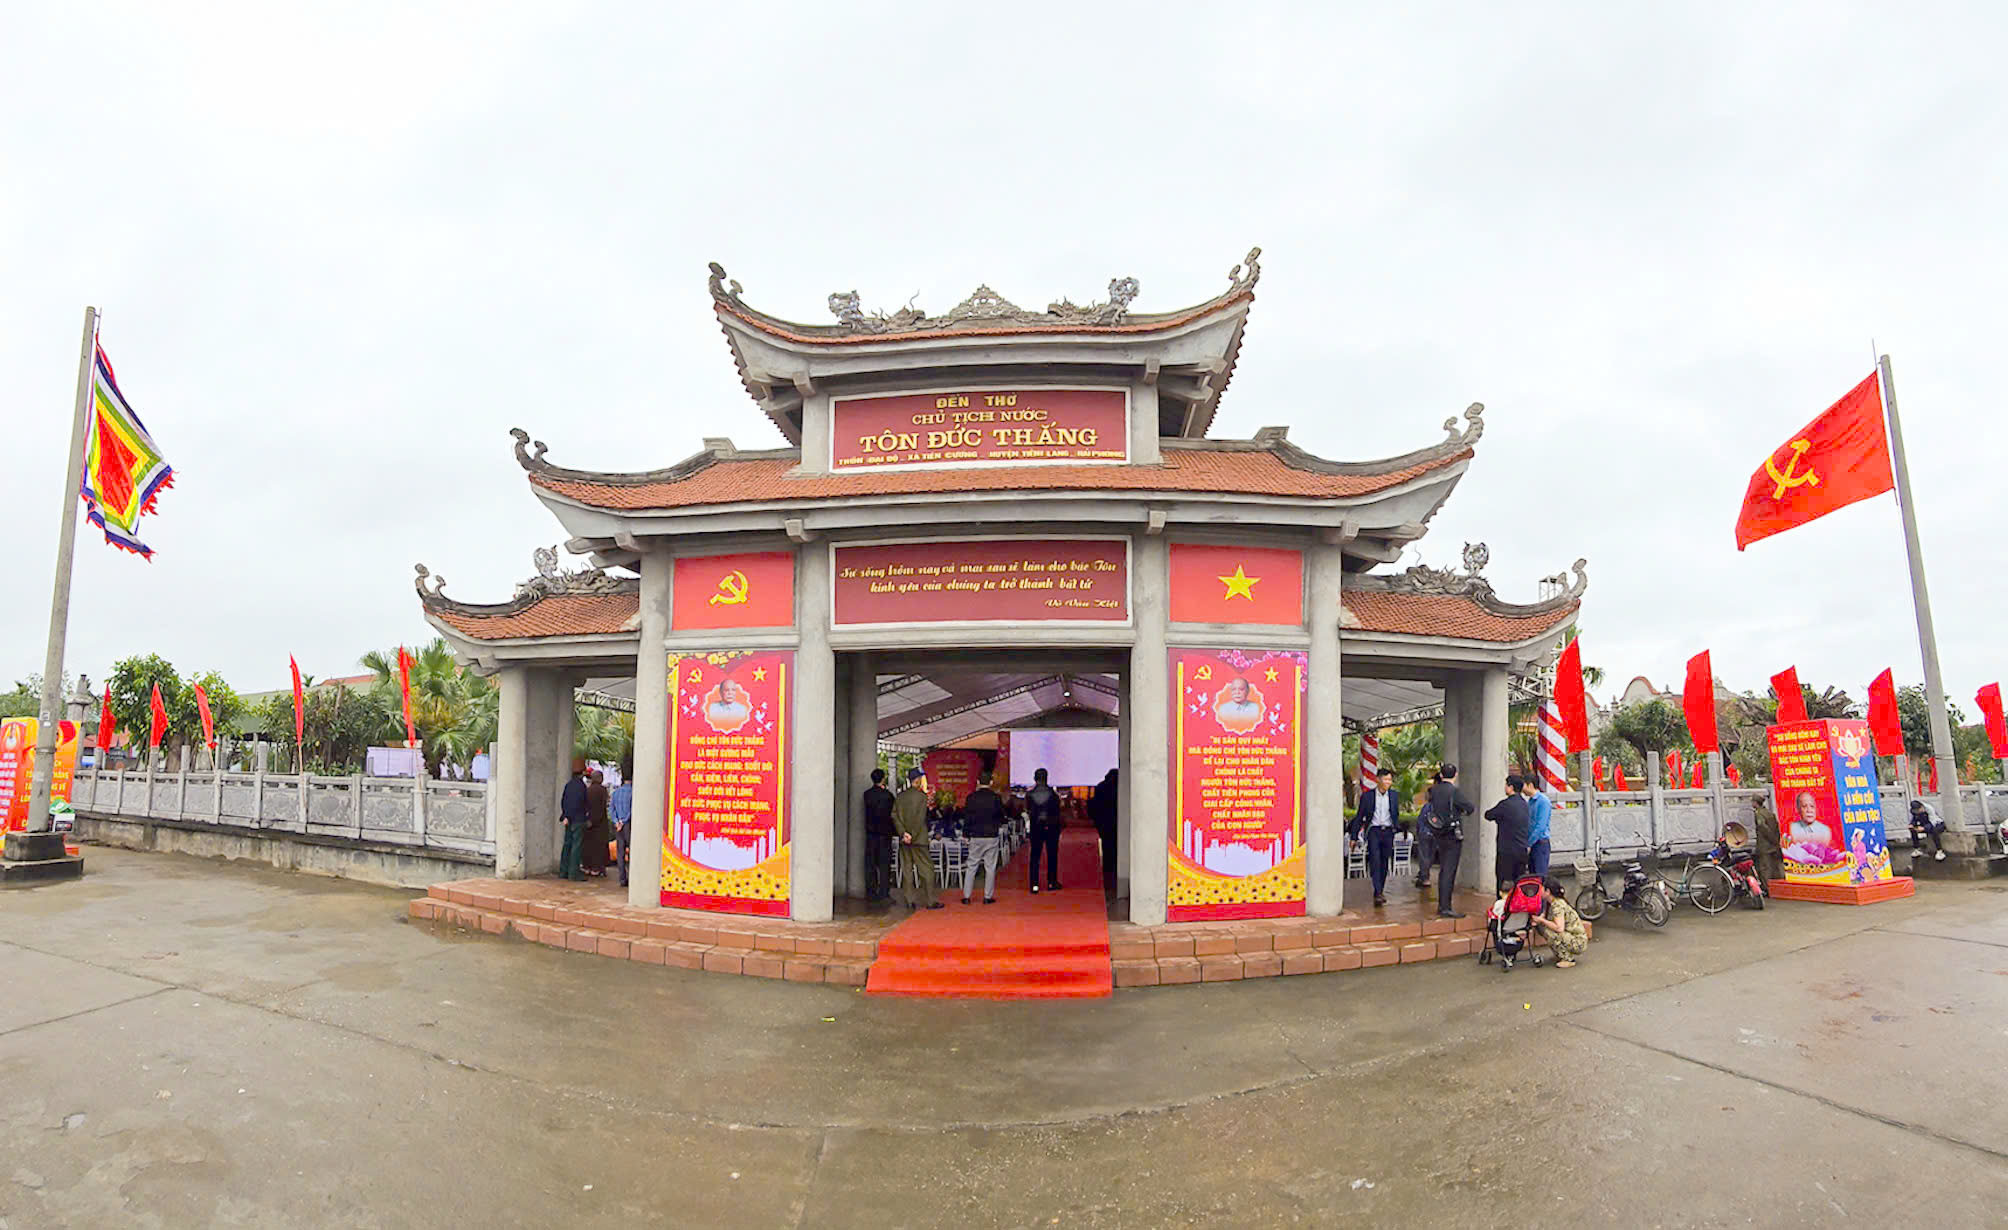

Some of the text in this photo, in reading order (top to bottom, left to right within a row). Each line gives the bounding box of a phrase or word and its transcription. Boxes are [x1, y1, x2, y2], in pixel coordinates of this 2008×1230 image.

[912, 407, 1048, 424] CHỦ TỊCH NƯỚC
[860, 421, 1098, 453] TÔN ĐỨC THẮNG
[860, 566, 886, 579] sống
[888, 563, 914, 576] hôm
[918, 565, 940, 577] nay
[1047, 561, 1067, 572] cho
[1094, 560, 1116, 571] Tôn
[870, 581, 895, 593] kính
[899, 582, 919, 595] yêu
[923, 580, 942, 591] của
[946, 579, 981, 592] chúng
[984, 579, 996, 589] ta
[1019, 577, 1054, 589] thành
